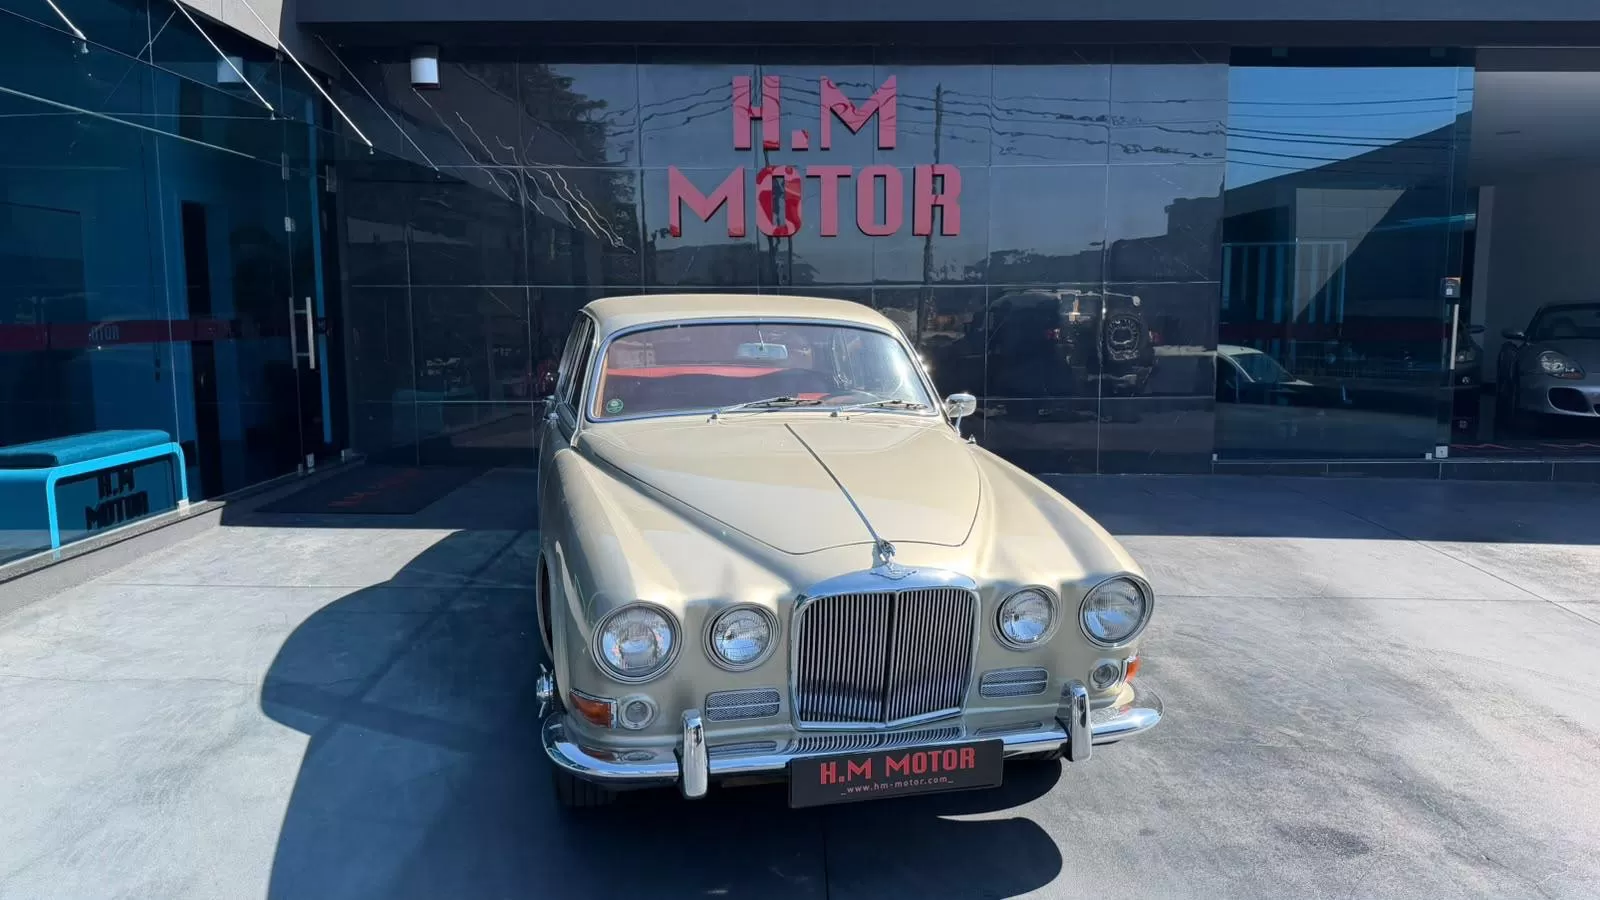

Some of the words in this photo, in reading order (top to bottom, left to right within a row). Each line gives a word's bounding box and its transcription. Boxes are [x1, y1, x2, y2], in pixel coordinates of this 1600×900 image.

[732, 75, 897, 151] H.M
[668, 164, 962, 237] MOTOR
[820, 758, 872, 785] H.M
[886, 747, 976, 777] MOTOR
